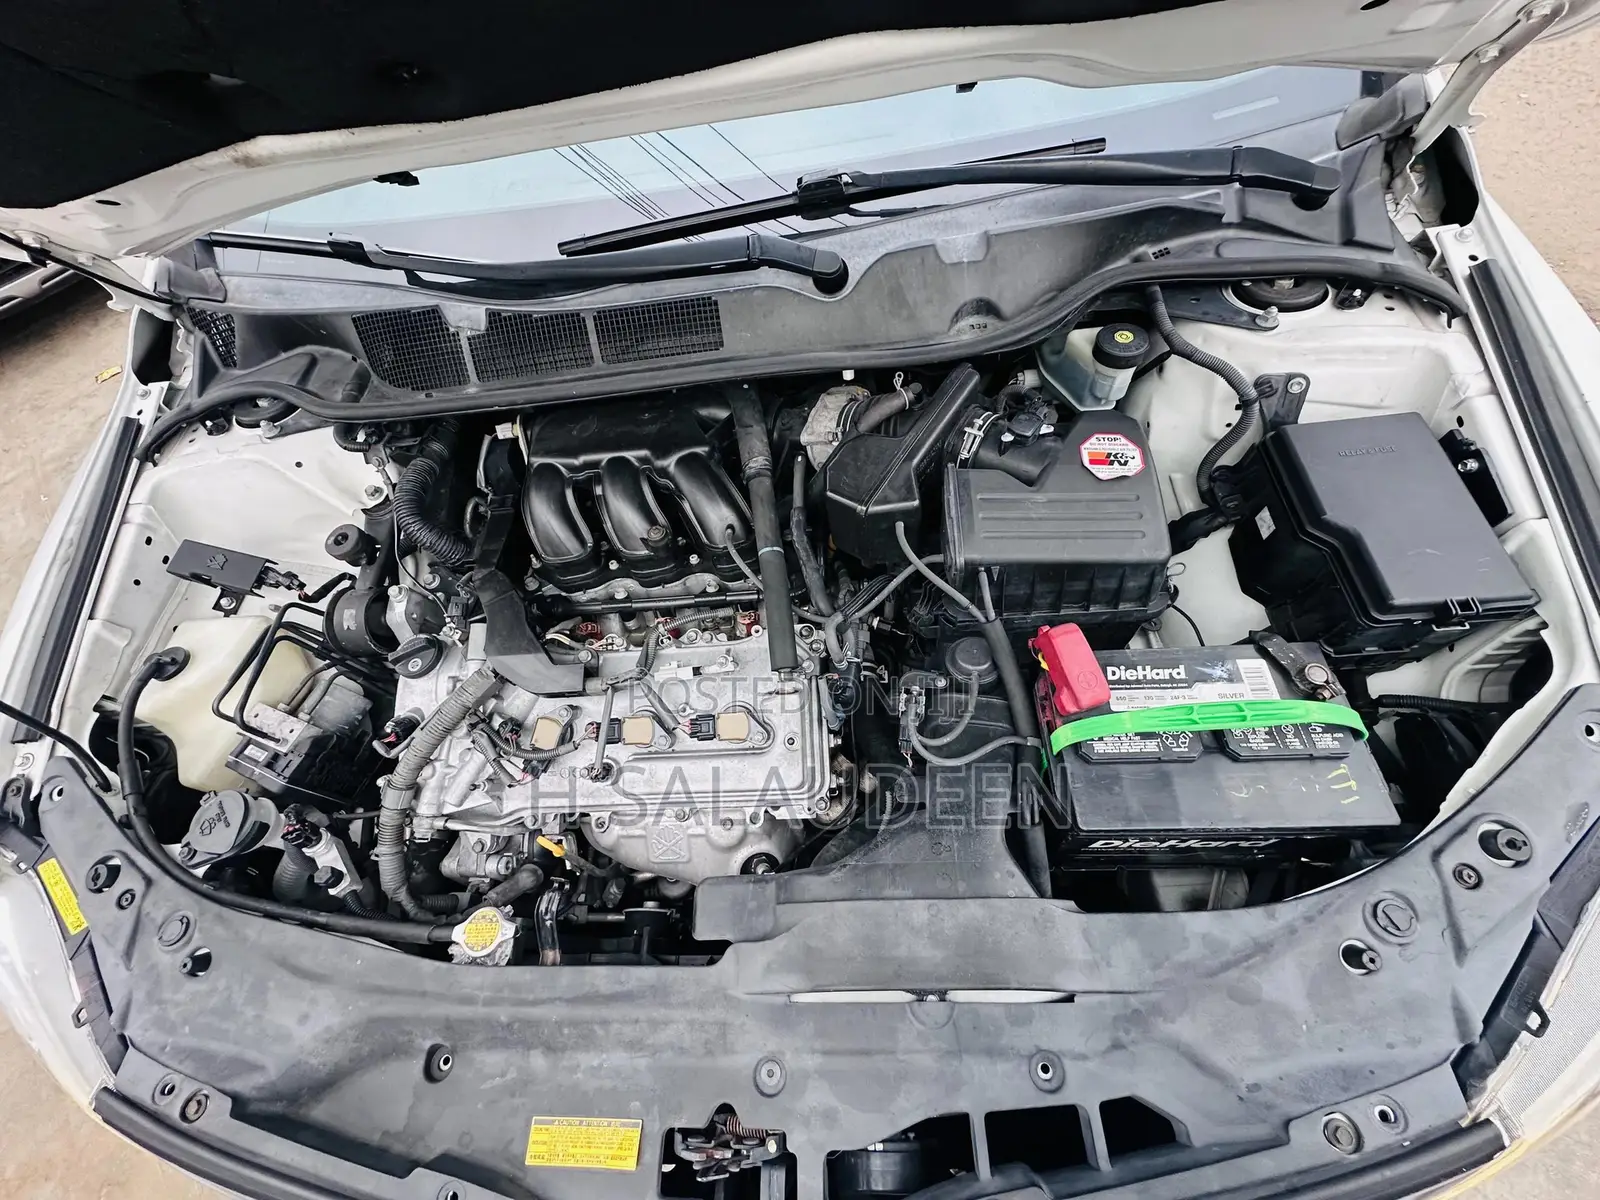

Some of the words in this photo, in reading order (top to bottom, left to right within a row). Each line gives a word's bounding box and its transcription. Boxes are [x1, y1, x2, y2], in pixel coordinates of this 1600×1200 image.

[1338, 448, 1366, 457] RELAY
[1374, 445, 1396, 453] FUSE
[1106, 664, 1186, 681] DieHard
[1088, 838, 1281, 848] DieHard
